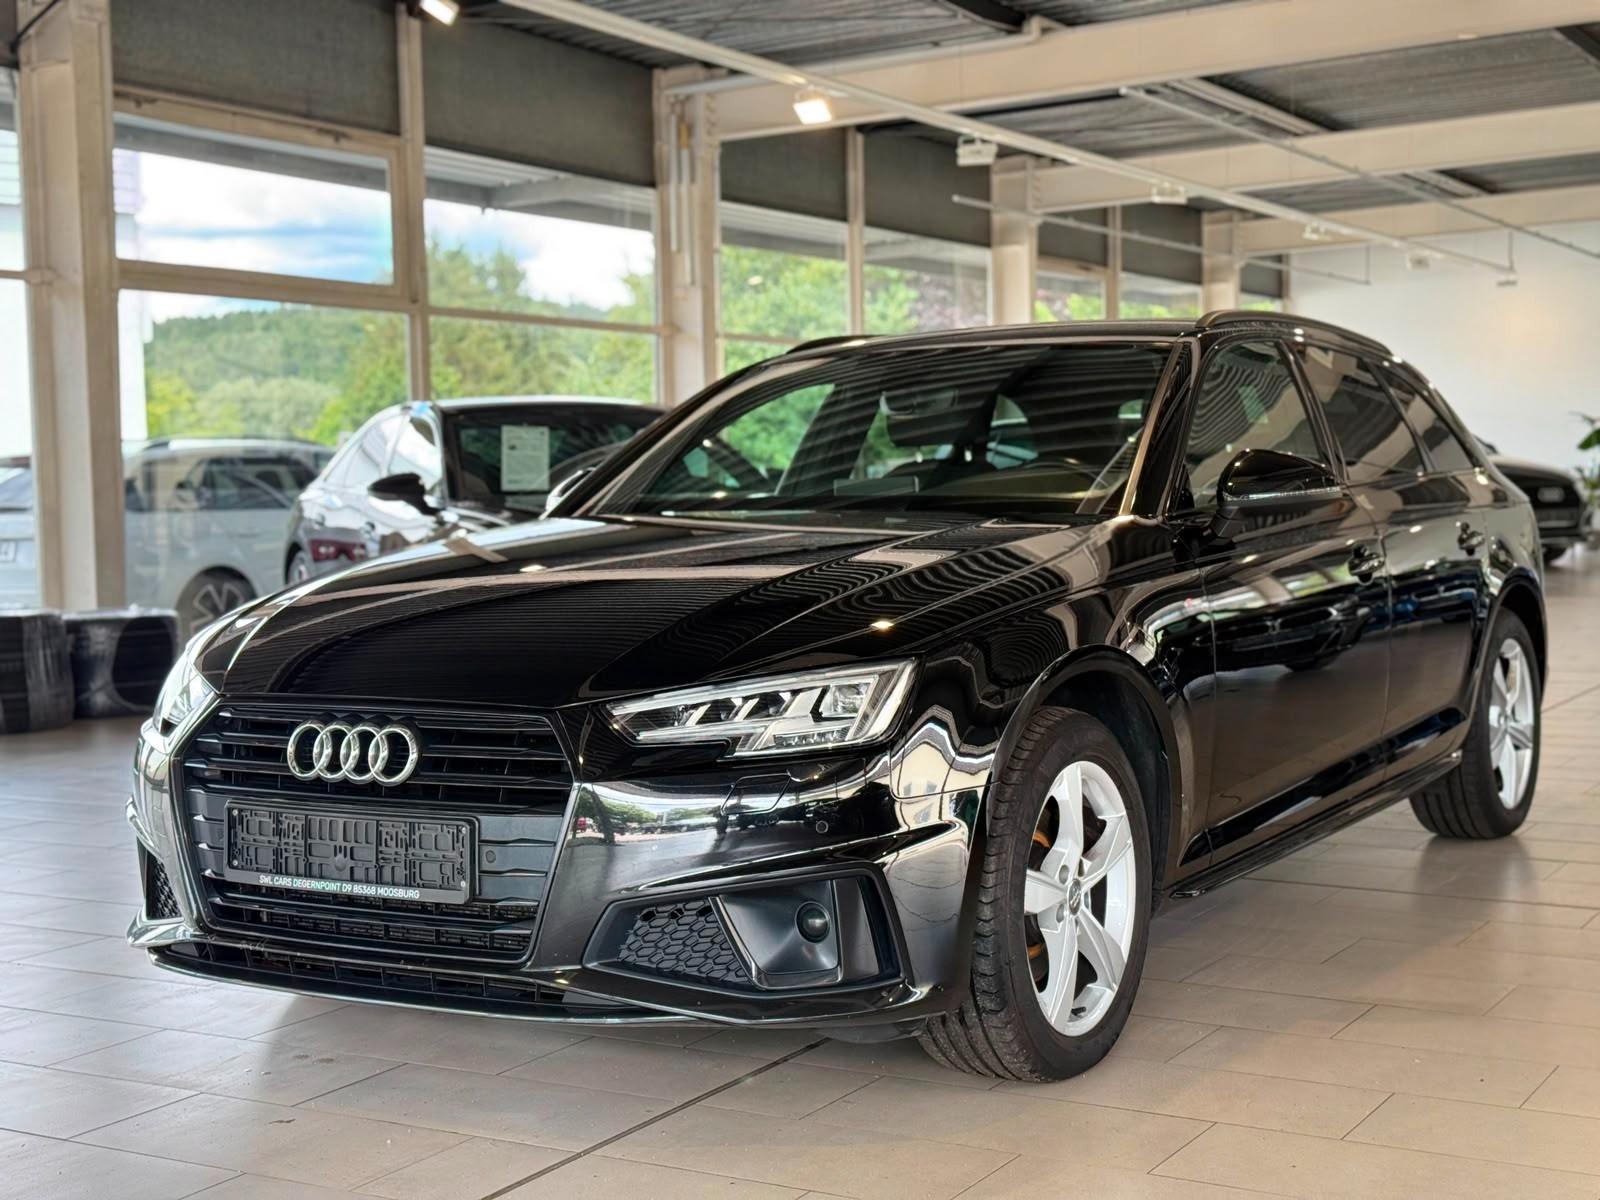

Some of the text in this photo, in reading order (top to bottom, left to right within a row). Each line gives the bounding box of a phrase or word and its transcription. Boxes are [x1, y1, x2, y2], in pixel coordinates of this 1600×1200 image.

[273, 876, 291, 887] CARS
[293, 879, 340, 891] DEGERNPOINT
[342, 883, 352, 893] D9
[353, 884, 376, 895] 85368
[377, 887, 420, 899] MOOSBURG
